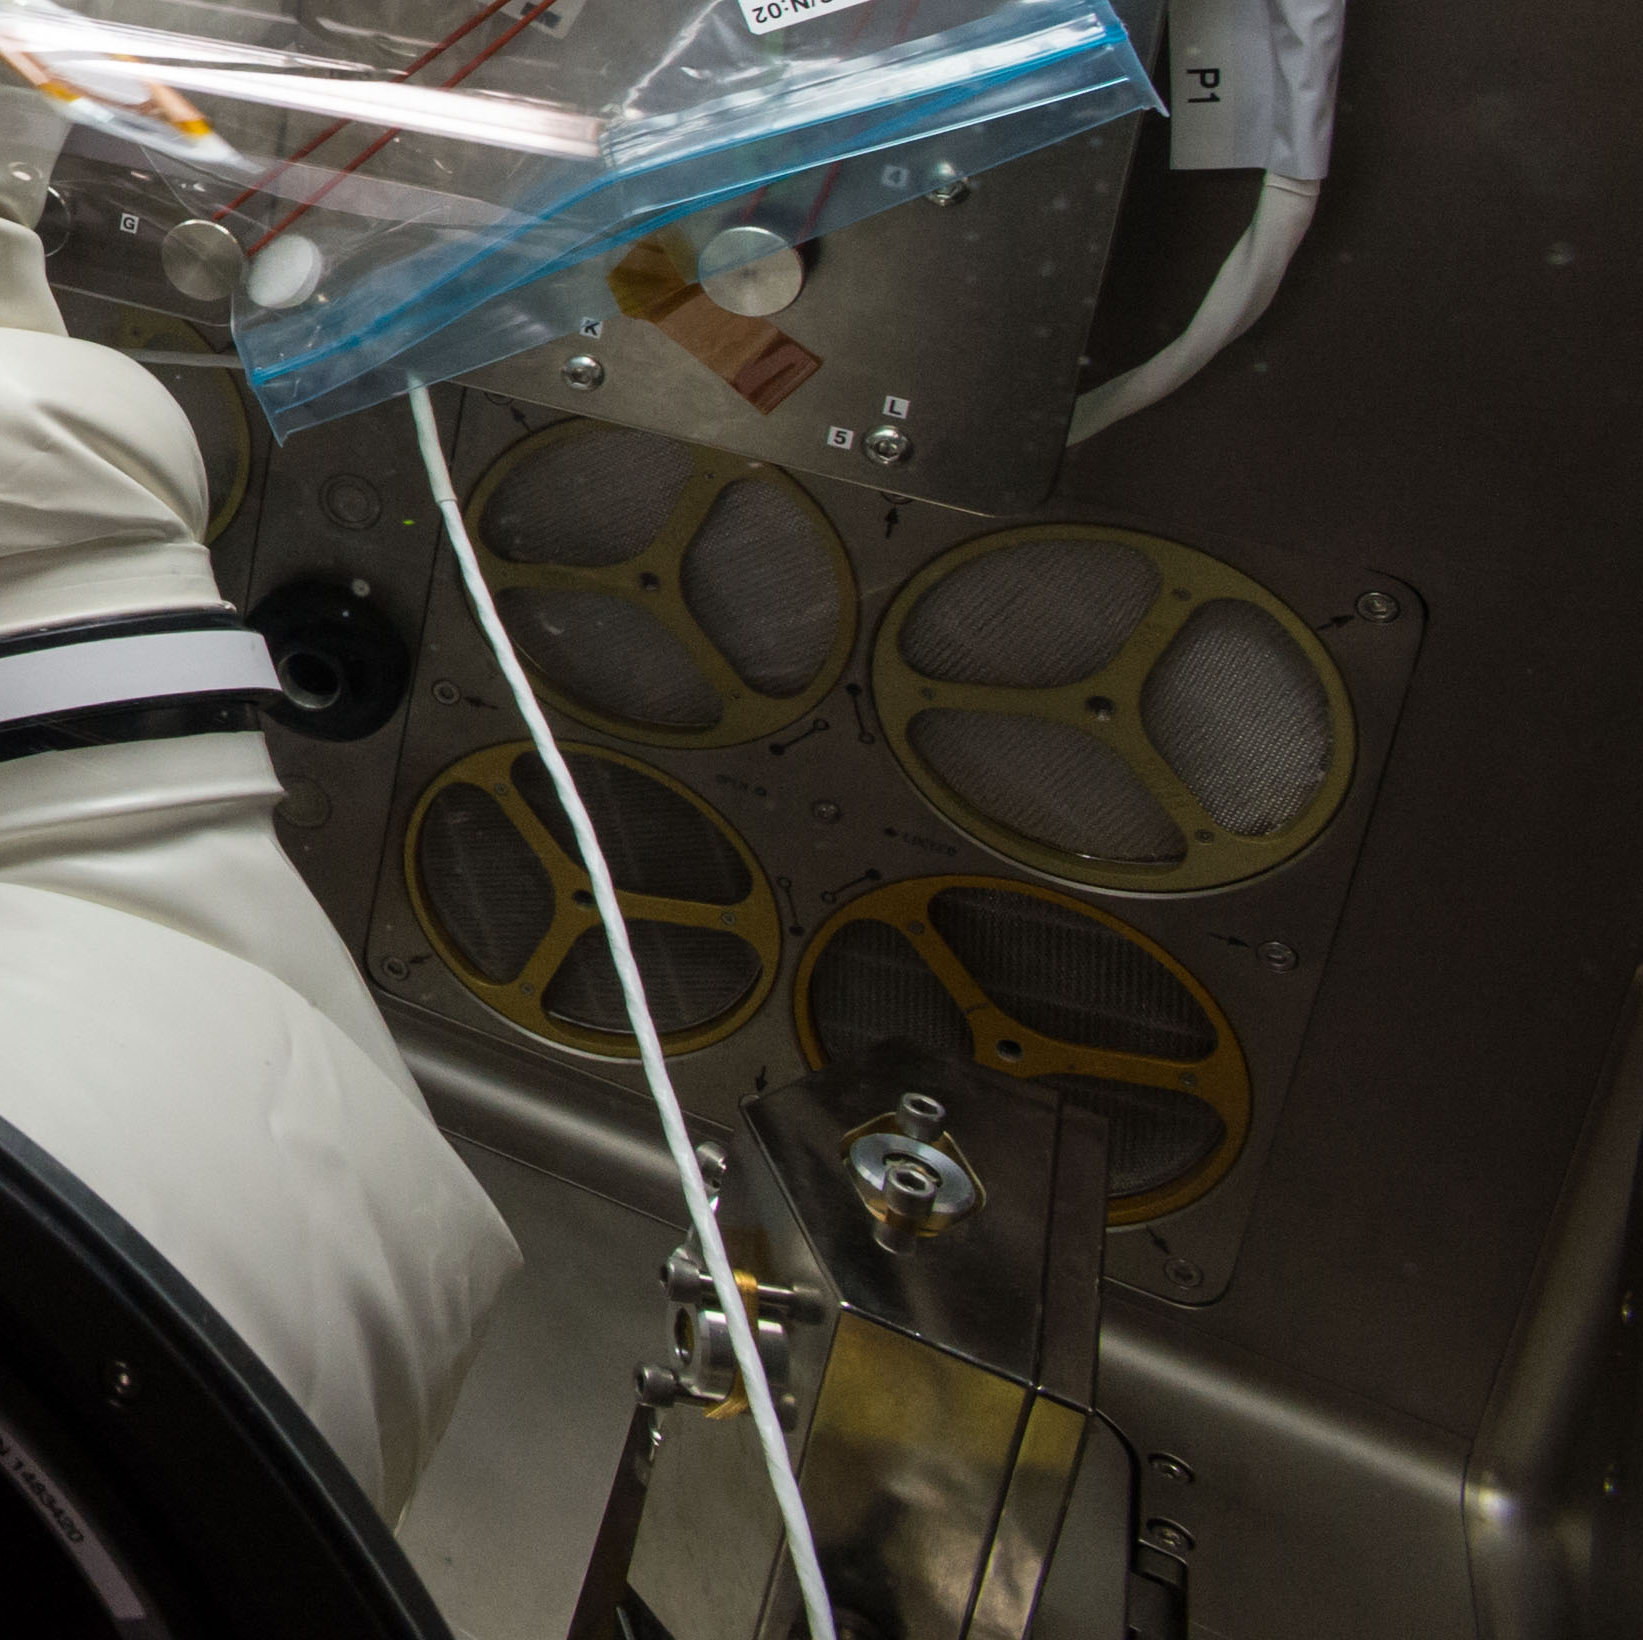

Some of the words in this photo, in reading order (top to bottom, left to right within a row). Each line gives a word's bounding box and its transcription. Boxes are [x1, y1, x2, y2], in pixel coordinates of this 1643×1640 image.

[1187, 68, 1220, 103] P1
[123, 217, 135, 230] G
[889, 399, 902, 416] L
[833, 430, 847, 445] 5
